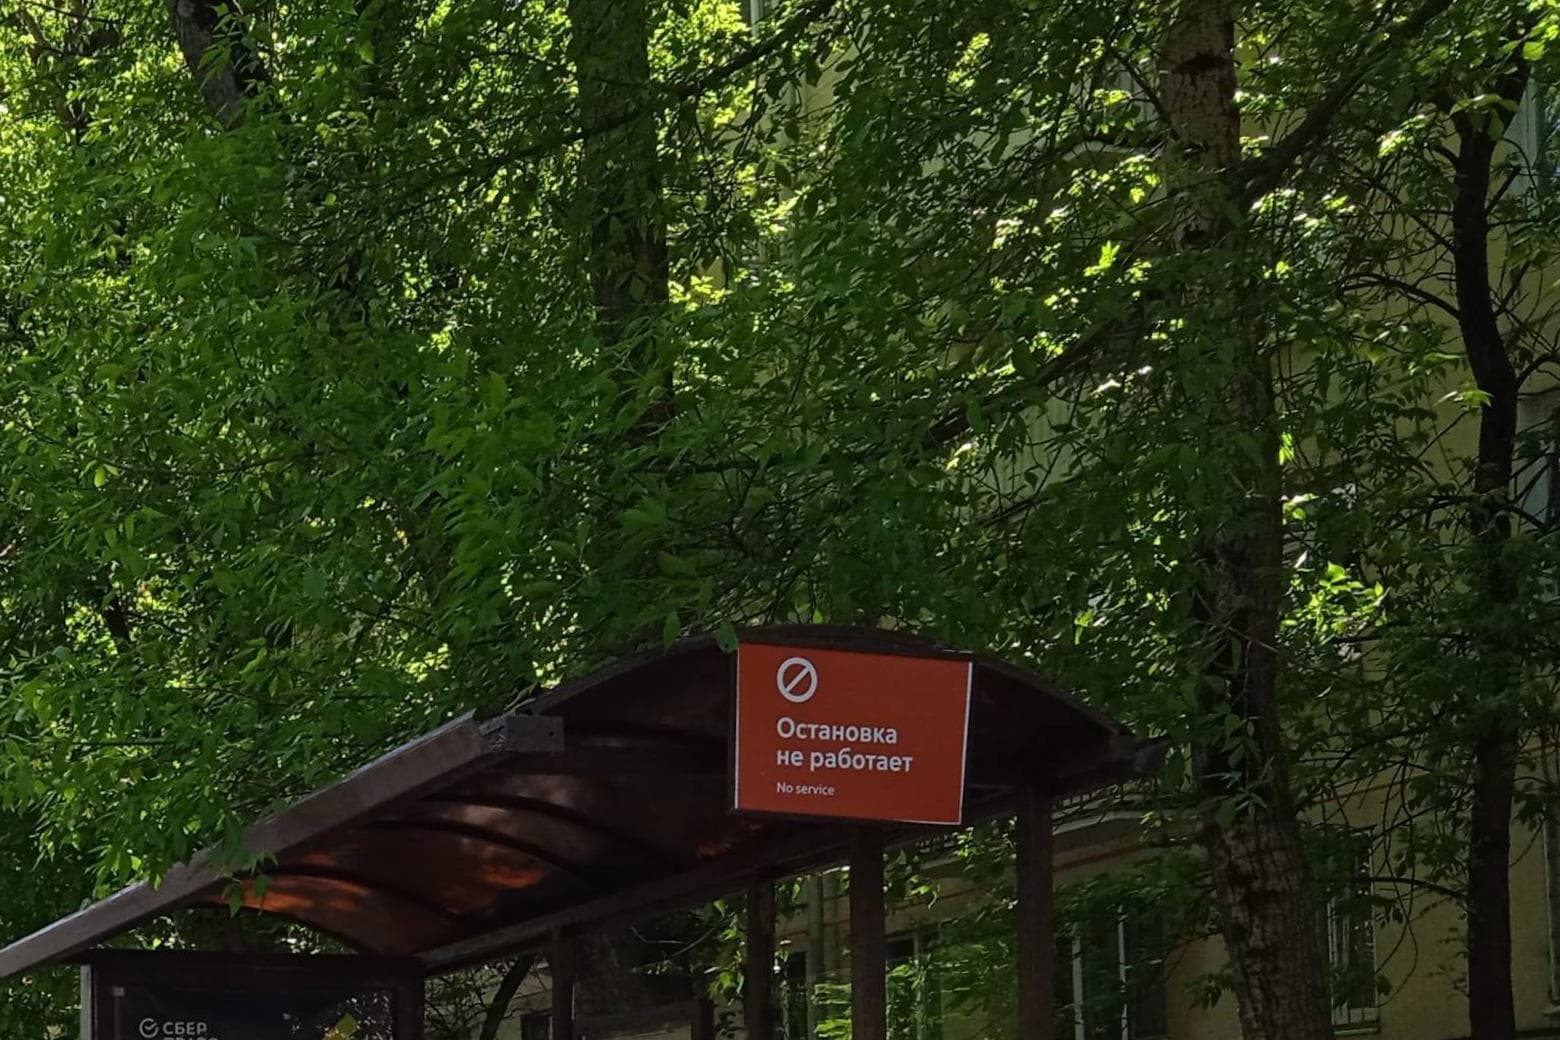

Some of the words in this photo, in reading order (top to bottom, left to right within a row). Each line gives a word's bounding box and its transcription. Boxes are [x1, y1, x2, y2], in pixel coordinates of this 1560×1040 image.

[777, 717, 898, 744] Остановка
[777, 749, 803, 767] не
[810, 747, 913, 773] работает
[776, 782, 793, 794] No
[795, 783, 835, 797] service
[163, 1021, 207, 1035] СБЕР
